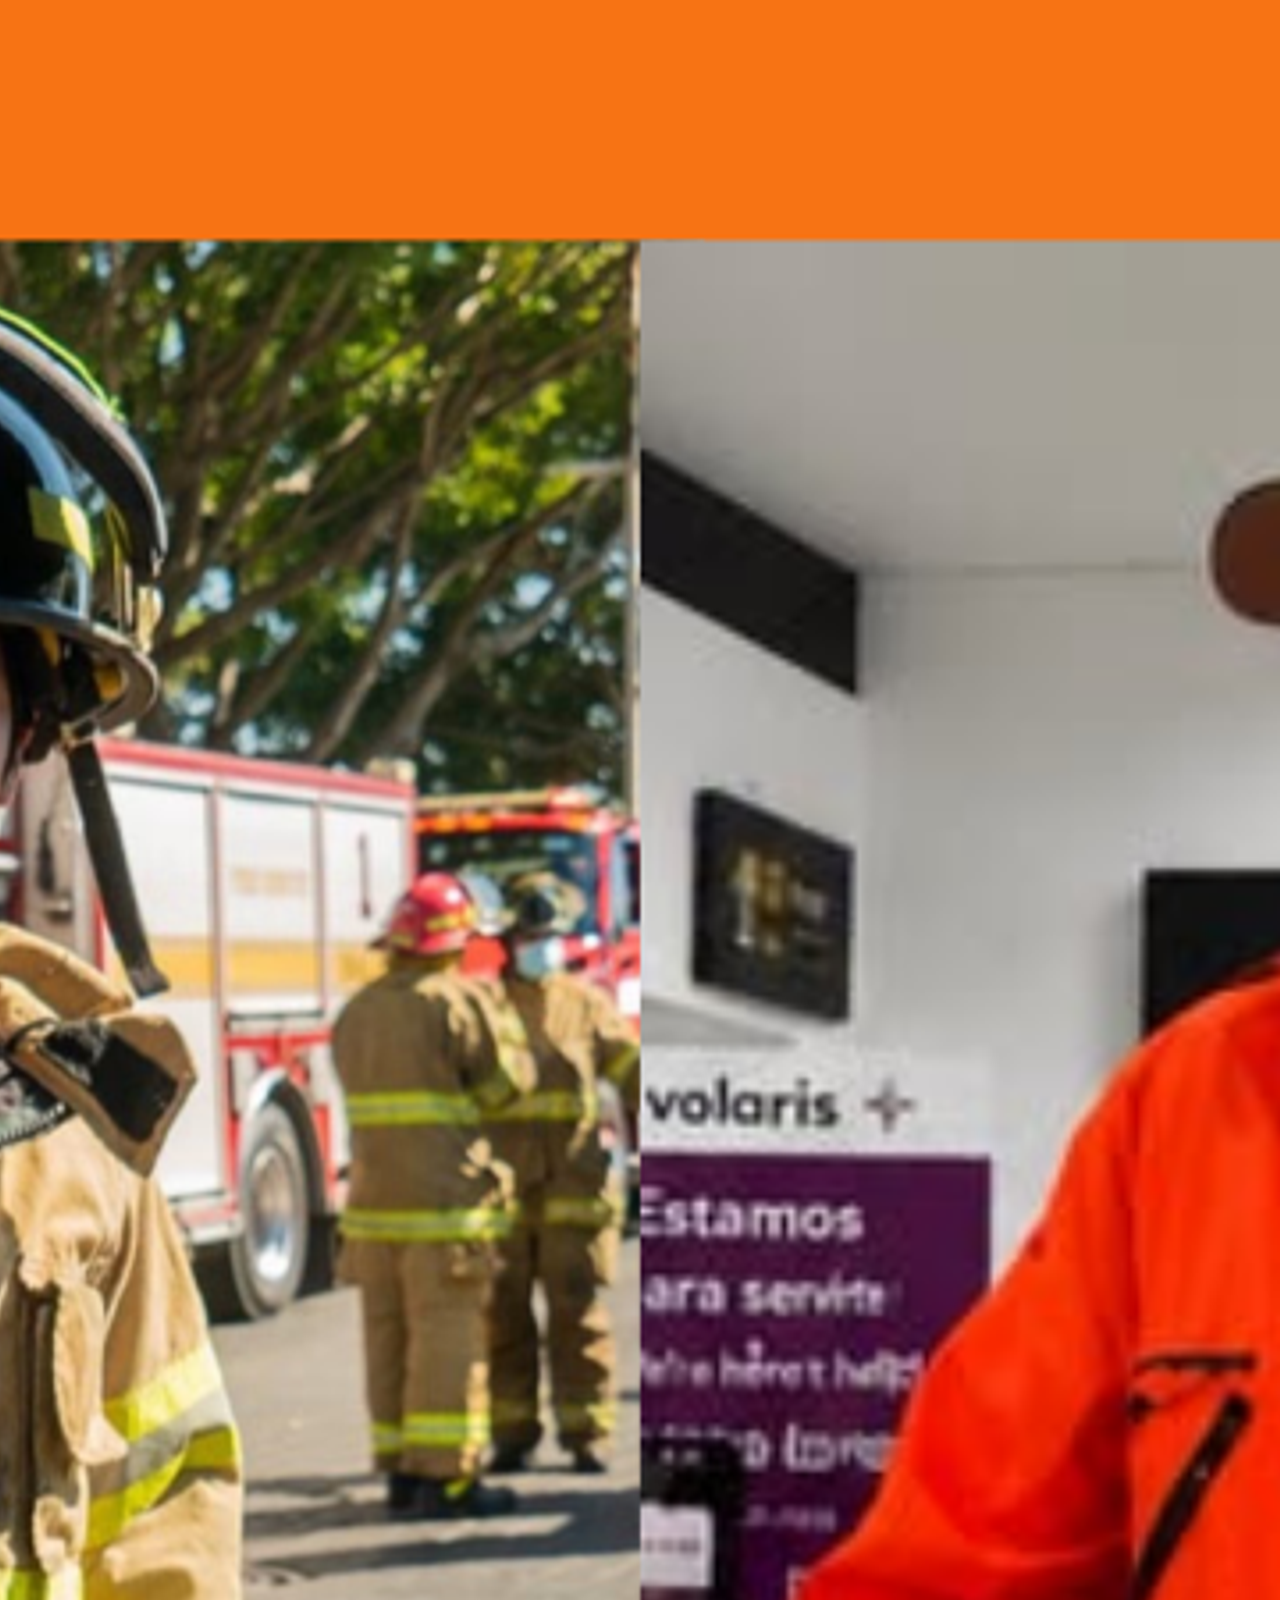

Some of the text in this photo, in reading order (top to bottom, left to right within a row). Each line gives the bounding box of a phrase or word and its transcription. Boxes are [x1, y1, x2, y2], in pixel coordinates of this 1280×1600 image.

[645, 1077, 838, 1127] volaris
[641, 1185, 867, 1240] Estamos
[643, 1274, 727, 1314] ara
